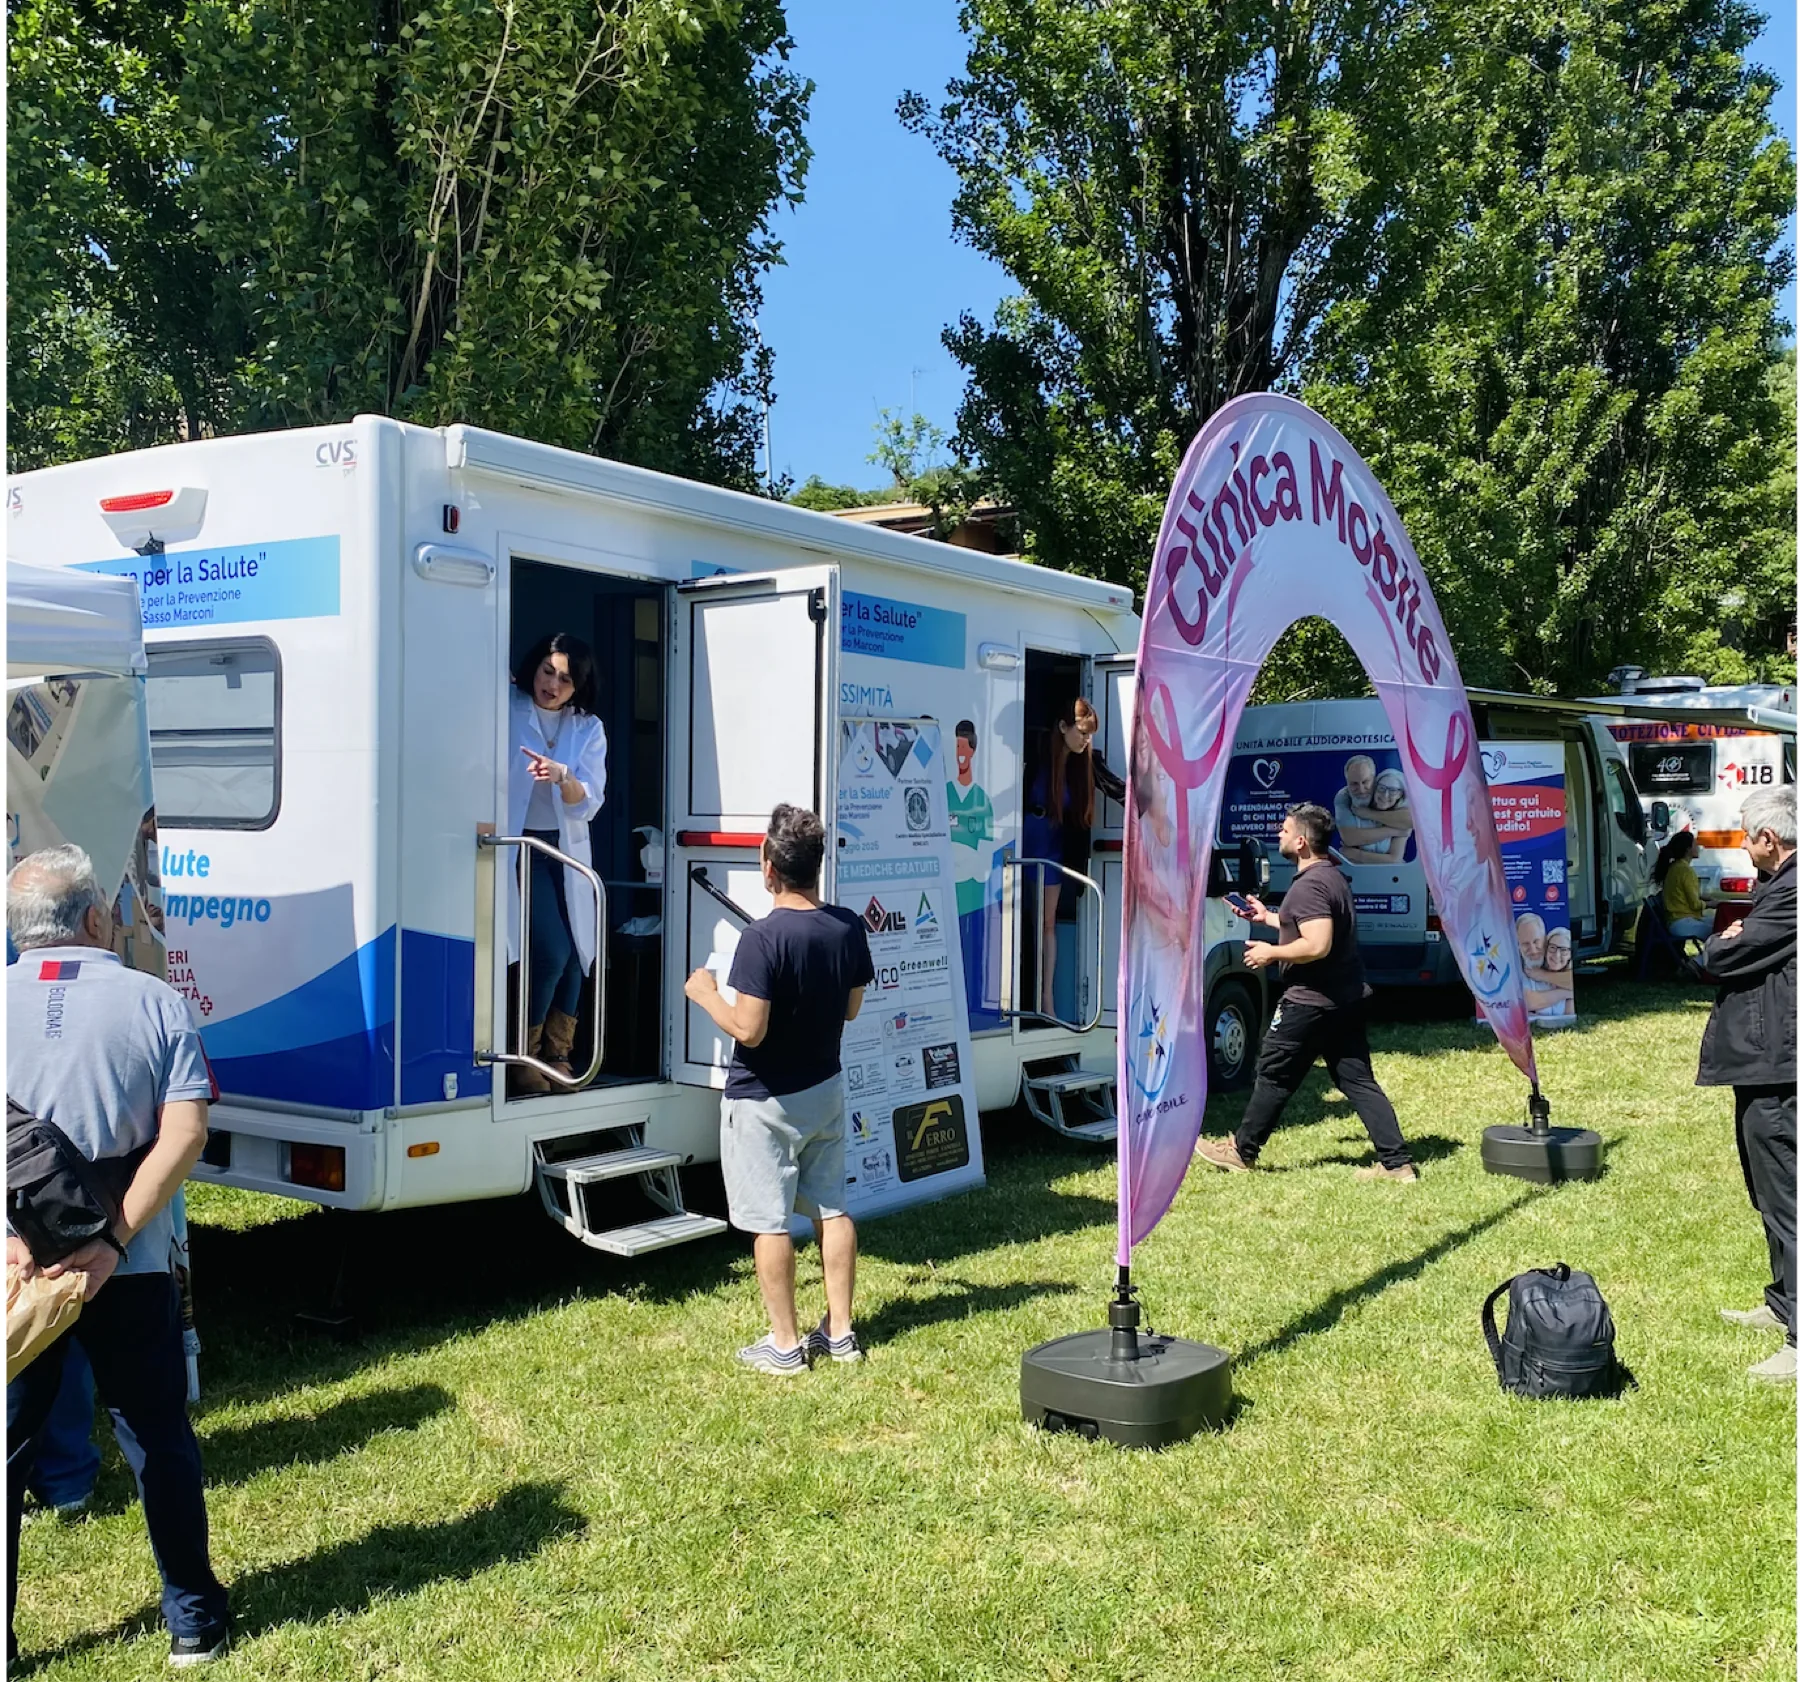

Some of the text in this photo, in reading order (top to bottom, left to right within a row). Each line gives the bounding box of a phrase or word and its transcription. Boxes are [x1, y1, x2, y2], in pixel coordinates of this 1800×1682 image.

[316, 440, 355, 464] CVS
[1166, 438, 1441, 685] Clinica Mobile
[143, 551, 267, 593] per la Salute"
[148, 595, 164, 609] per
[166, 593, 176, 605] la
[178, 588, 242, 604] Prevenzione
[143, 605, 214, 624] Sasso Marconi
[842, 600, 922, 629] er la Salute"
[858, 625, 905, 643] Prevenzione
[854, 637, 885, 653] Marconi
[841, 683, 893, 708] SSIMITÀ
[1236, 734, 1396, 750] UNITÀ MOBILE AUDIOPROTESICA
[1741, 765, 1772, 785] 118
[839, 789, 848, 799] er
[1492, 794, 1539, 808] ttua qui
[1493, 808, 1562, 820] est gratuito
[1496, 820, 1531, 832] udito!
[162, 846, 210, 877] lute
[838, 860, 939, 878] TE MEDICHE GRATUITE
[168, 950, 188, 965] ERI
[900, 956, 948, 971] Greenwell
